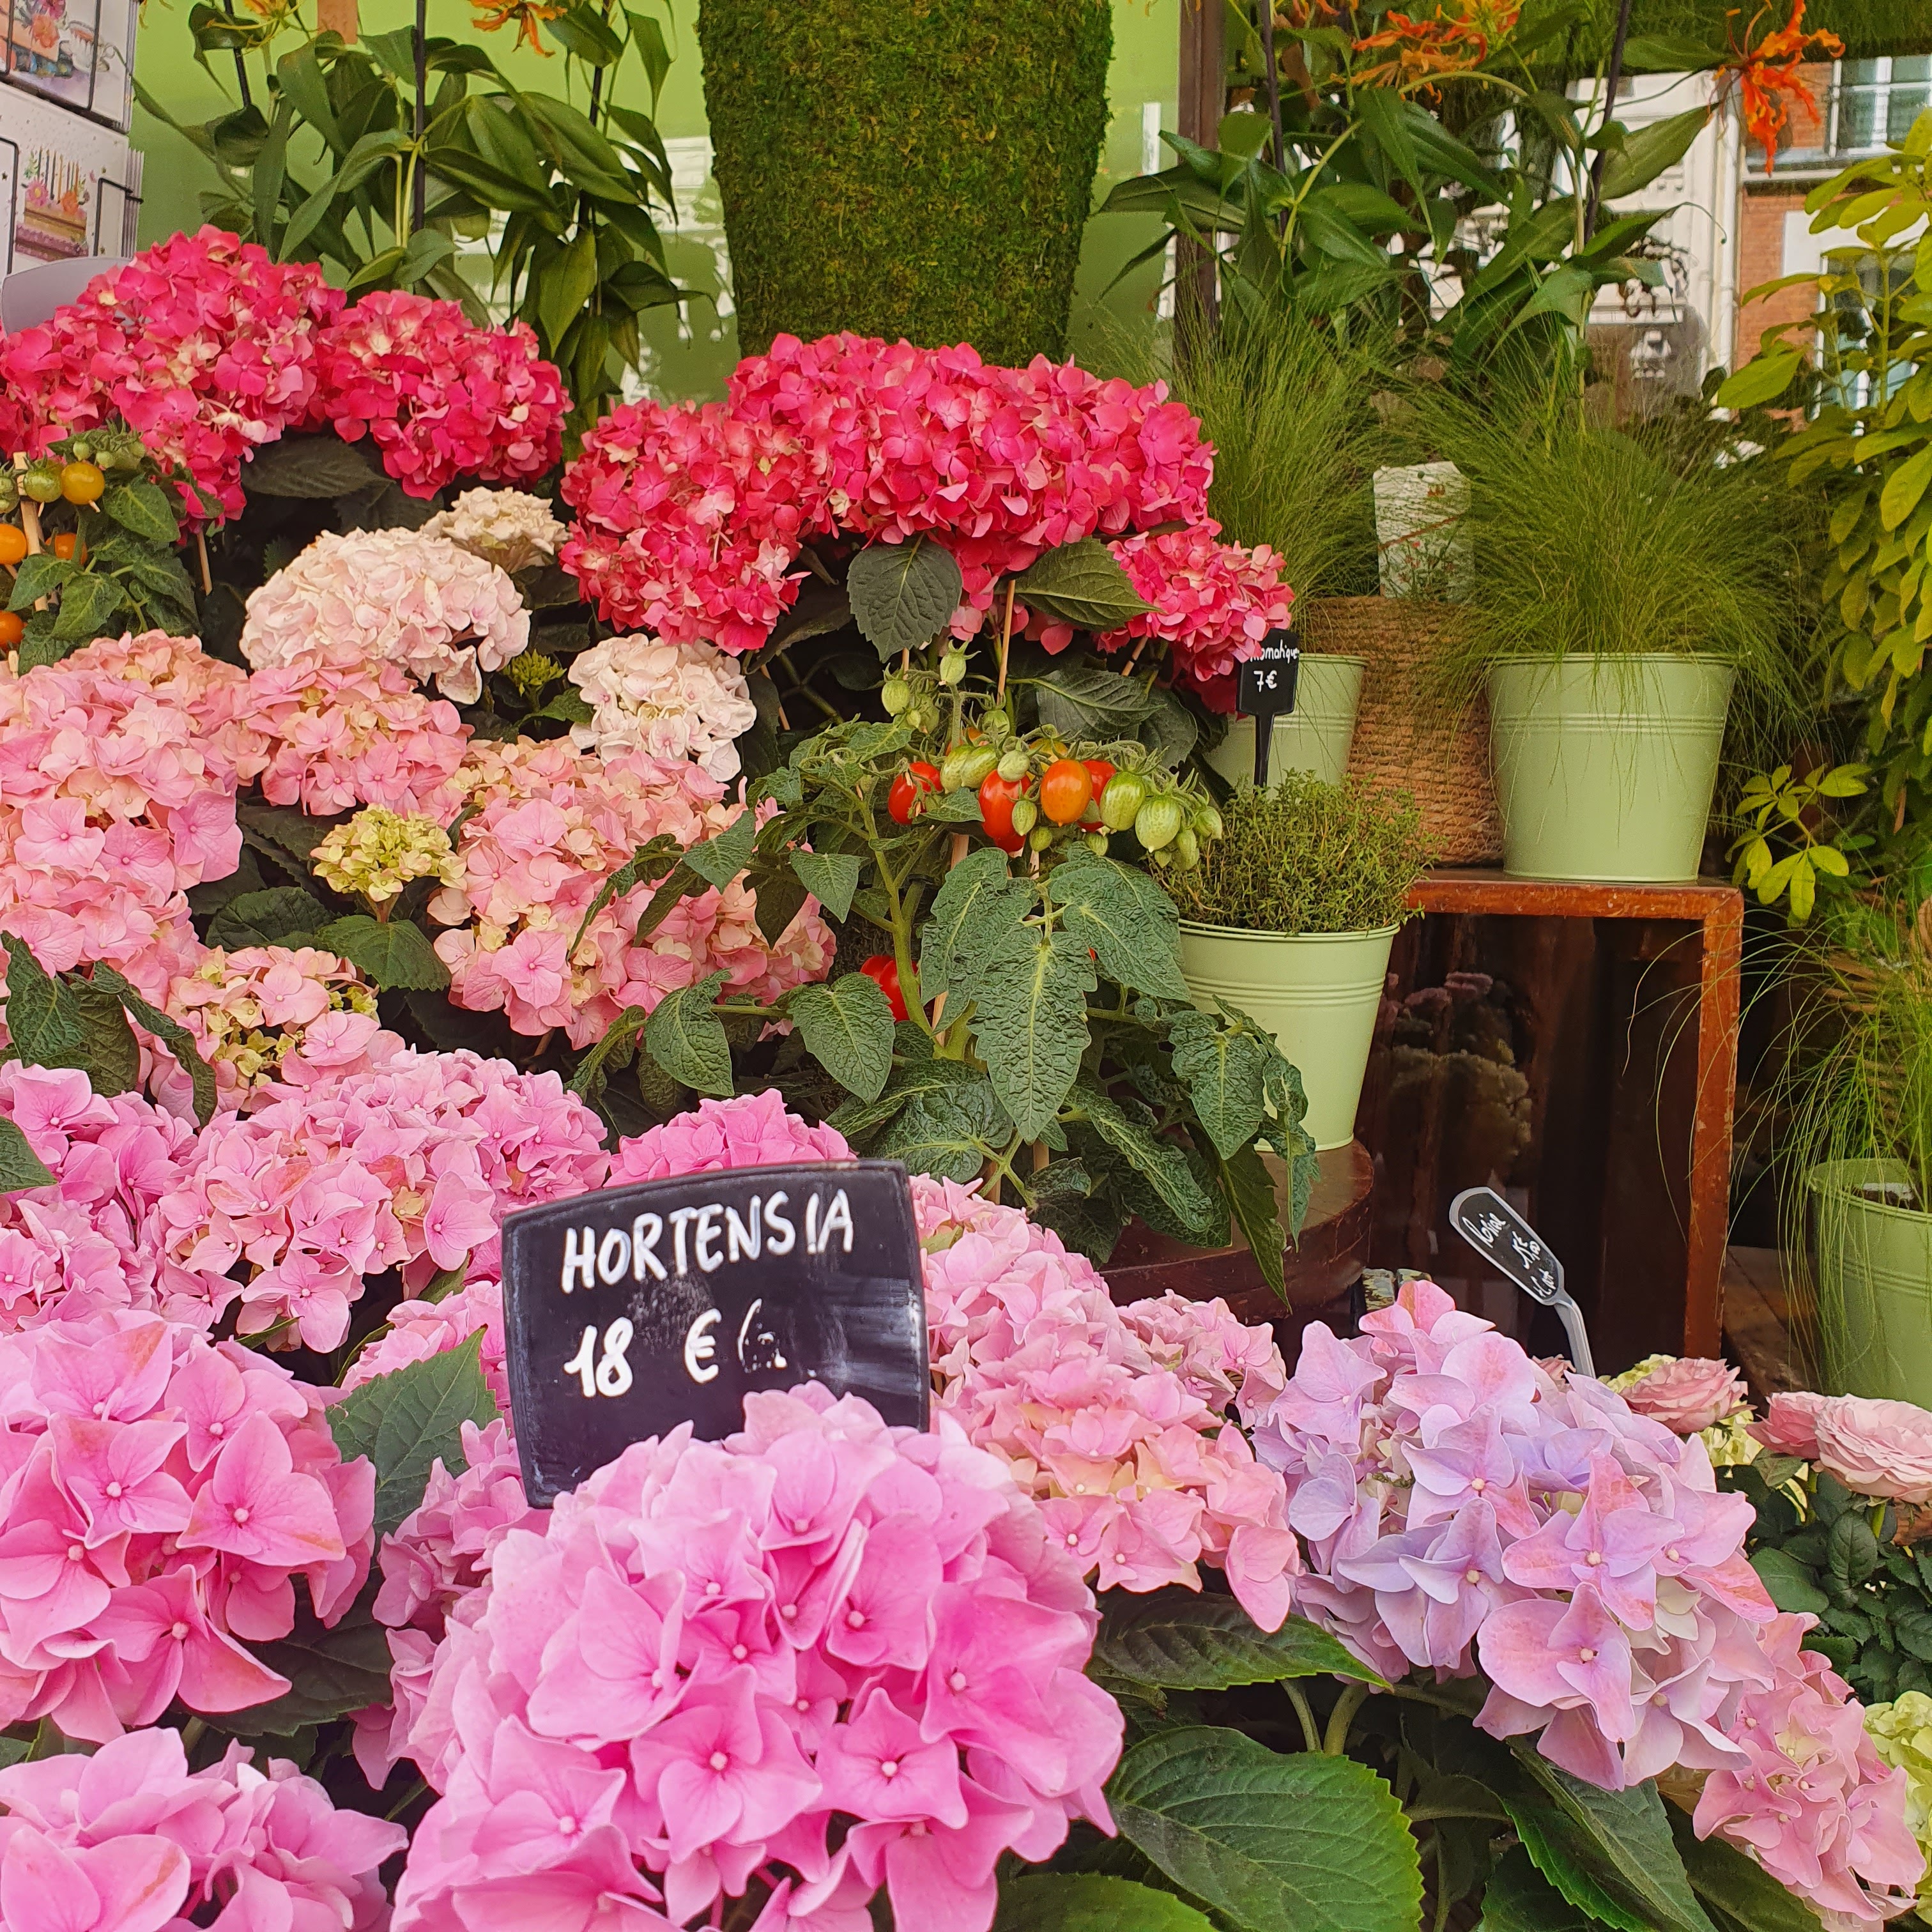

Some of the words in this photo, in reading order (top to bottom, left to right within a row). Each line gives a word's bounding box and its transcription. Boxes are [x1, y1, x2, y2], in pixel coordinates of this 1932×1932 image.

[1254, 670, 1277, 693] 7€
[560, 1190, 853, 1293] HORTENSIA
[564, 1317, 634, 1397] 18
